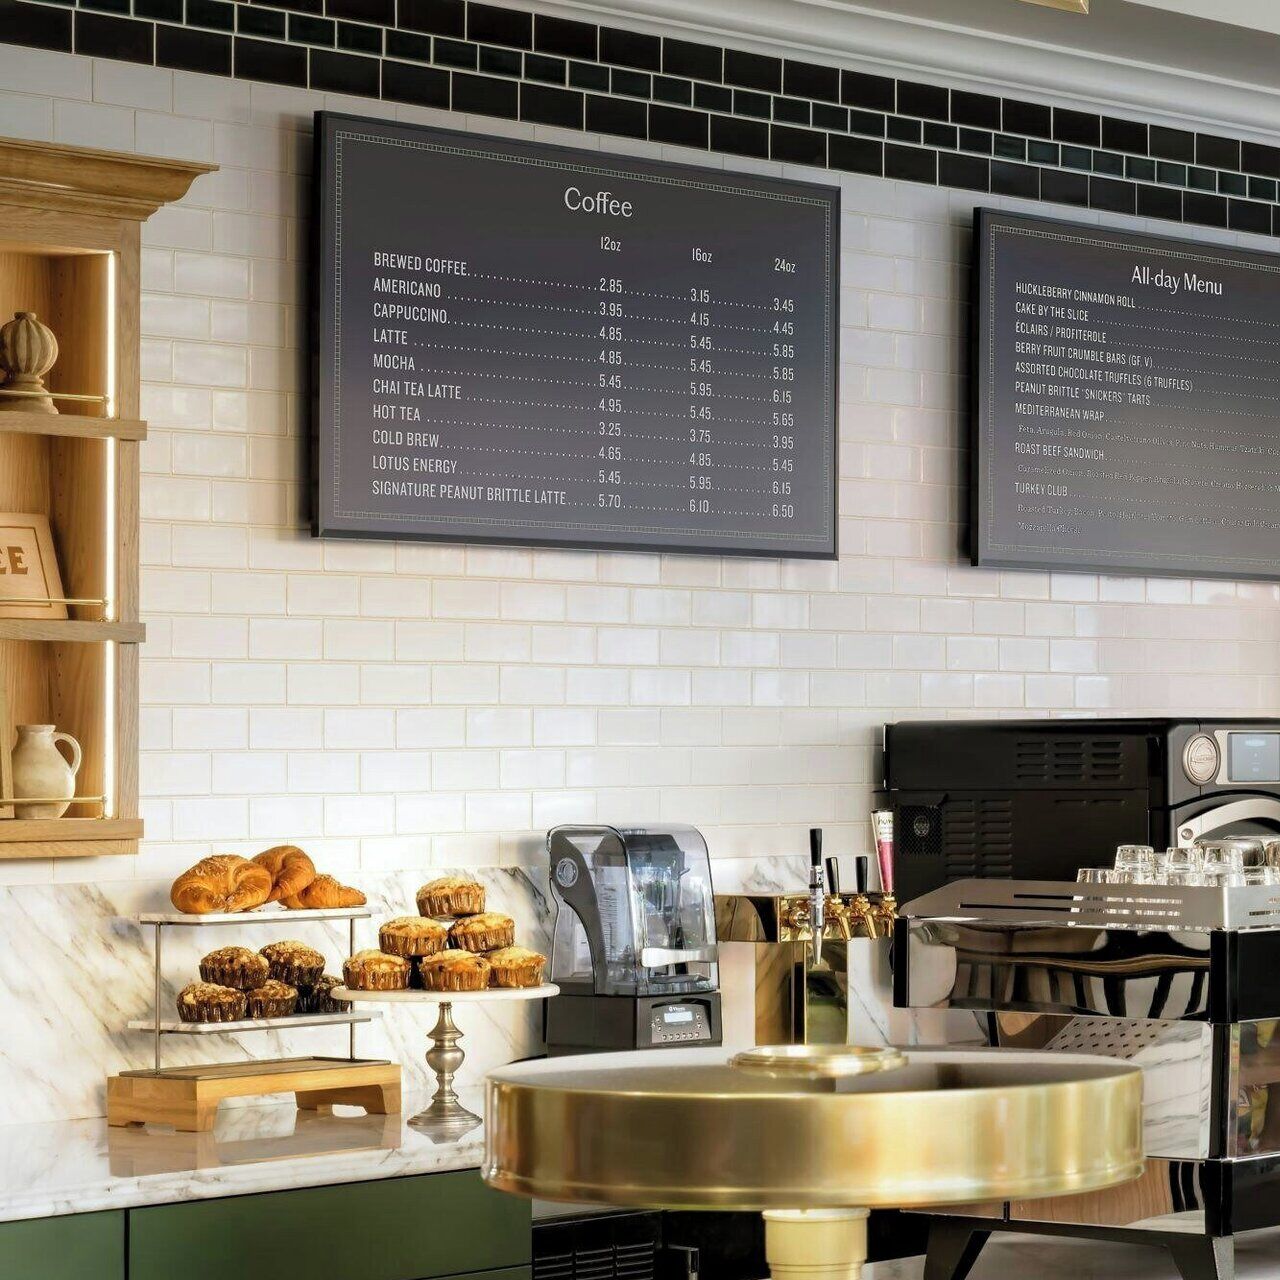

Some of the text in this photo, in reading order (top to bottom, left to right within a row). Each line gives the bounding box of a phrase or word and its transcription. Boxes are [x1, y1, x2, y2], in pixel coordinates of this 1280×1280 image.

[564, 186, 633, 217] Coffee
[600, 236, 796, 273] 12oz 16oz 24oz
[374, 252, 794, 313] BREWED COFFEE 2.85 3.15 3.45
[1015, 281, 1072, 300] HUCKLEBERRY
[1074, 289, 1115, 305] CINNAMON
[1116, 295, 1136, 309] ROLL
[1131, 265, 1222, 295] All-day Menu
[373, 278, 794, 336] AMERICANO 3.95 4.15 4.45
[1015, 301, 1036, 315] CAKE
[1038, 304, 1048, 316] BY
[1050, 306, 1065, 319] THE
[1067, 308, 1089, 322] SLICE
[373, 303, 794, 358] CAPPUCCINO 4.85 5.45 5.85
[1056, 327, 1107, 344] PROFITEROLE
[373, 328, 794, 381] LATTE 4.85 5.45 5.85
[1015, 341, 1041, 355] BERRY
[1043, 345, 1065, 358] FRUIT
[1067, 348, 1104, 363] CRUMBLE
[1106, 352, 1126, 365] BARS
[373, 354, 792, 404] MOCHA 5.45 5.95 6.15
[1015, 361, 1056, 377] ASSORTED
[1058, 366, 1102, 382] CHOCOLATE
[1105, 371, 1142, 386] TRUFFLES
[1154, 377, 1193, 393] TRUFFLES)
[1015, 381, 1046, 395] PEANUT
[1048, 384, 1079, 399] BRITTLE
[1128, 392, 1151, 406] TARTS
[373, 379, 794, 427] CHAI TEA LATTE 4.95 5.45 5.65
[1015, 402, 1081, 419] MEDITERRANEAN
[1083, 409, 1105, 422] WRAP
[373, 404, 794, 450] HOT TEA 3.25 3.75 3.95
[372, 429, 793, 472] COLD BREW 4.65 4.85 5.45
[1015, 442, 1041, 455] ROAST
[1043, 444, 1061, 457] BEEF
[1063, 446, 1104, 461] SANDWICH
[372, 455, 791, 495] LOTUS ENERGY 5.45 5.95 6.15
[1015, 482, 1046, 495] TURKEY
[1047, 484, 1068, 497] CLUB
[372, 480, 794, 518] SIGNATURE PEANUT BRITTLE LATTE 5.70 6.10 6.50
